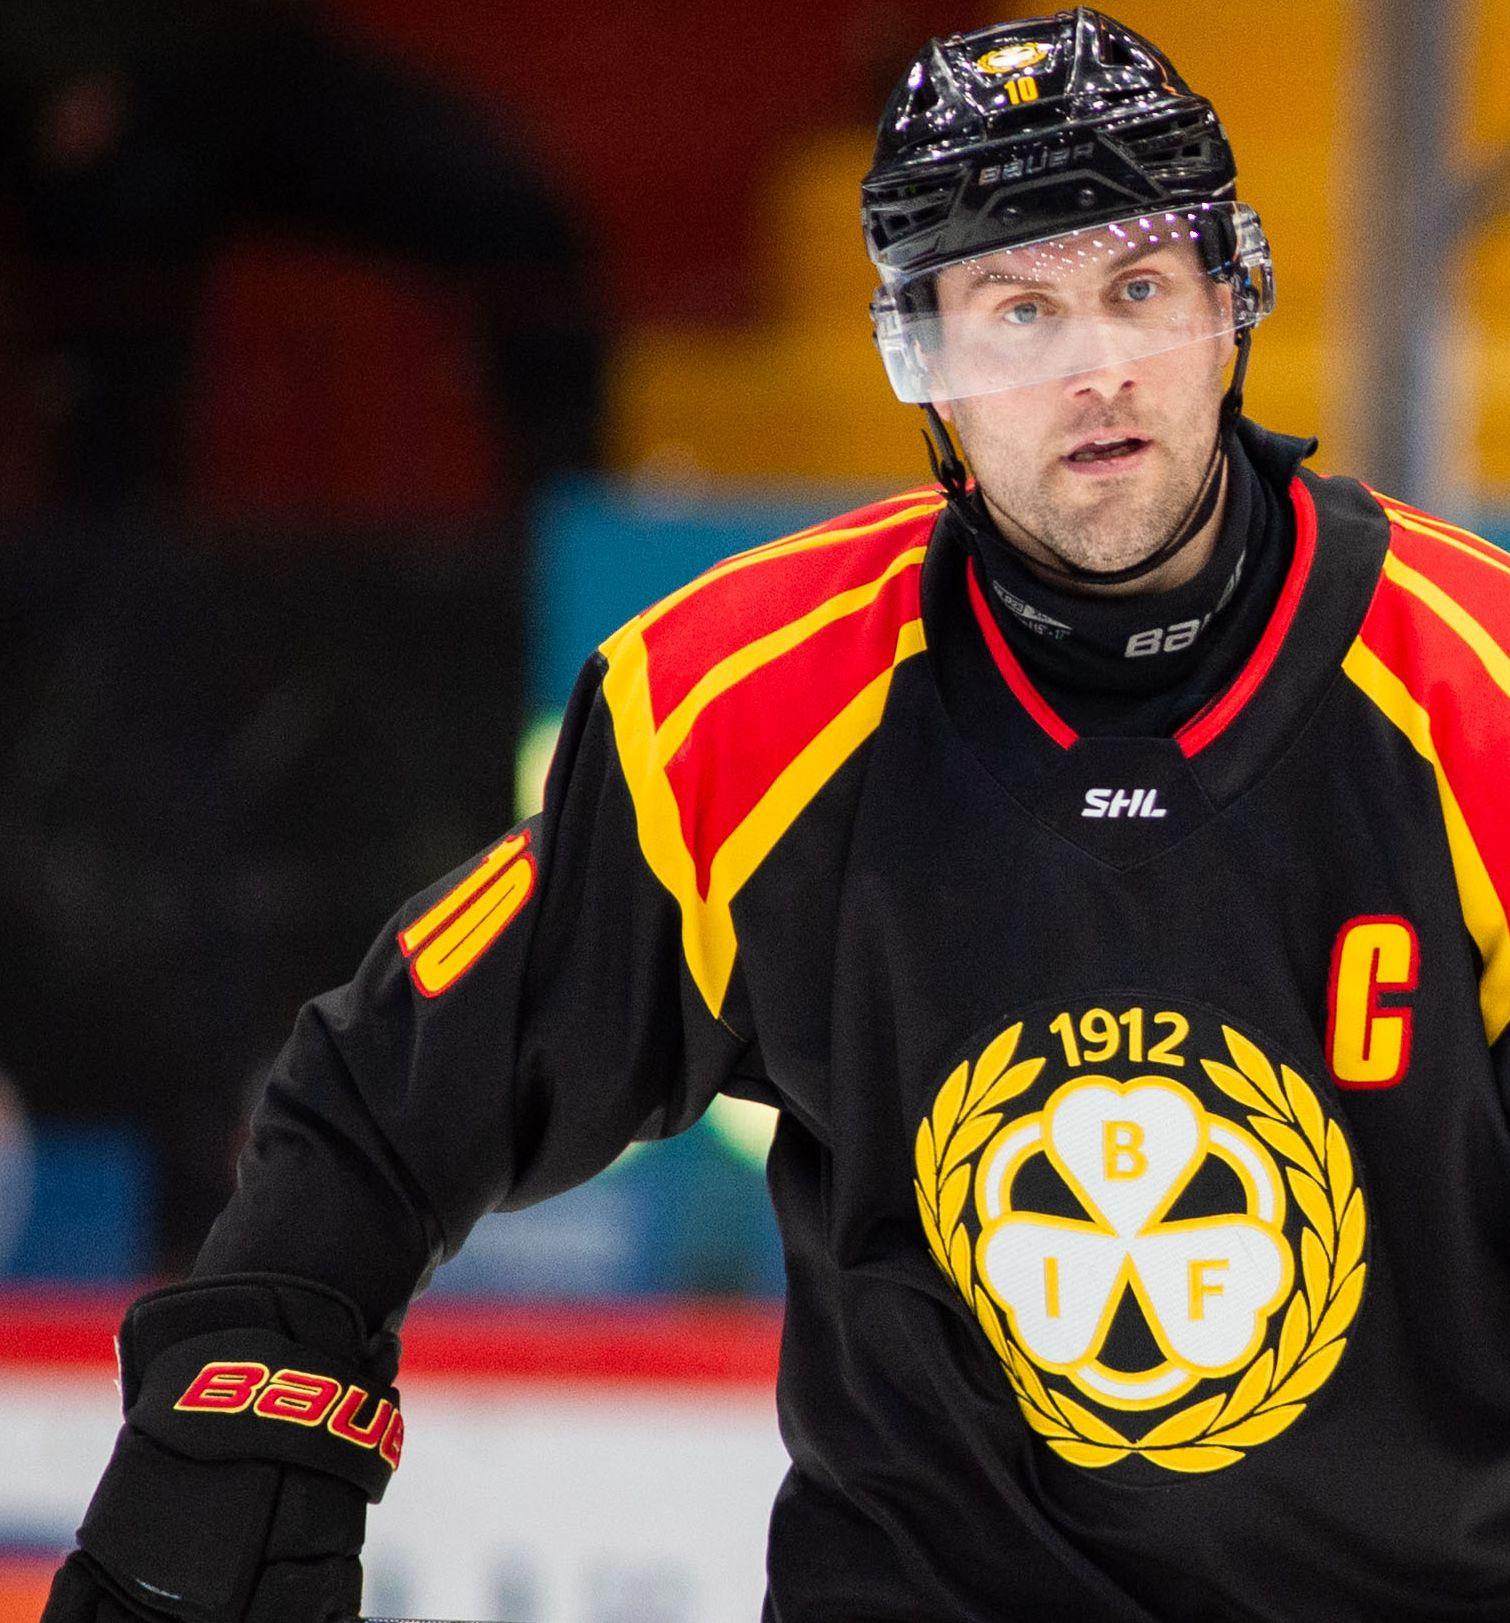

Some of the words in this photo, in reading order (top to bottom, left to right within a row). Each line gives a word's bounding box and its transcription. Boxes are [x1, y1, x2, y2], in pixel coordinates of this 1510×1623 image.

[1004, 76, 1039, 105] 10
[978, 141, 1095, 186] BAUER
[1081, 788, 1167, 818] SHL
[397, 827, 539, 999] 10
[1325, 914, 1420, 1090] C
[1049, 1007, 1189, 1067] 1912
[1102, 1119, 1148, 1182] B
[1187, 1258, 1230, 1321] F
